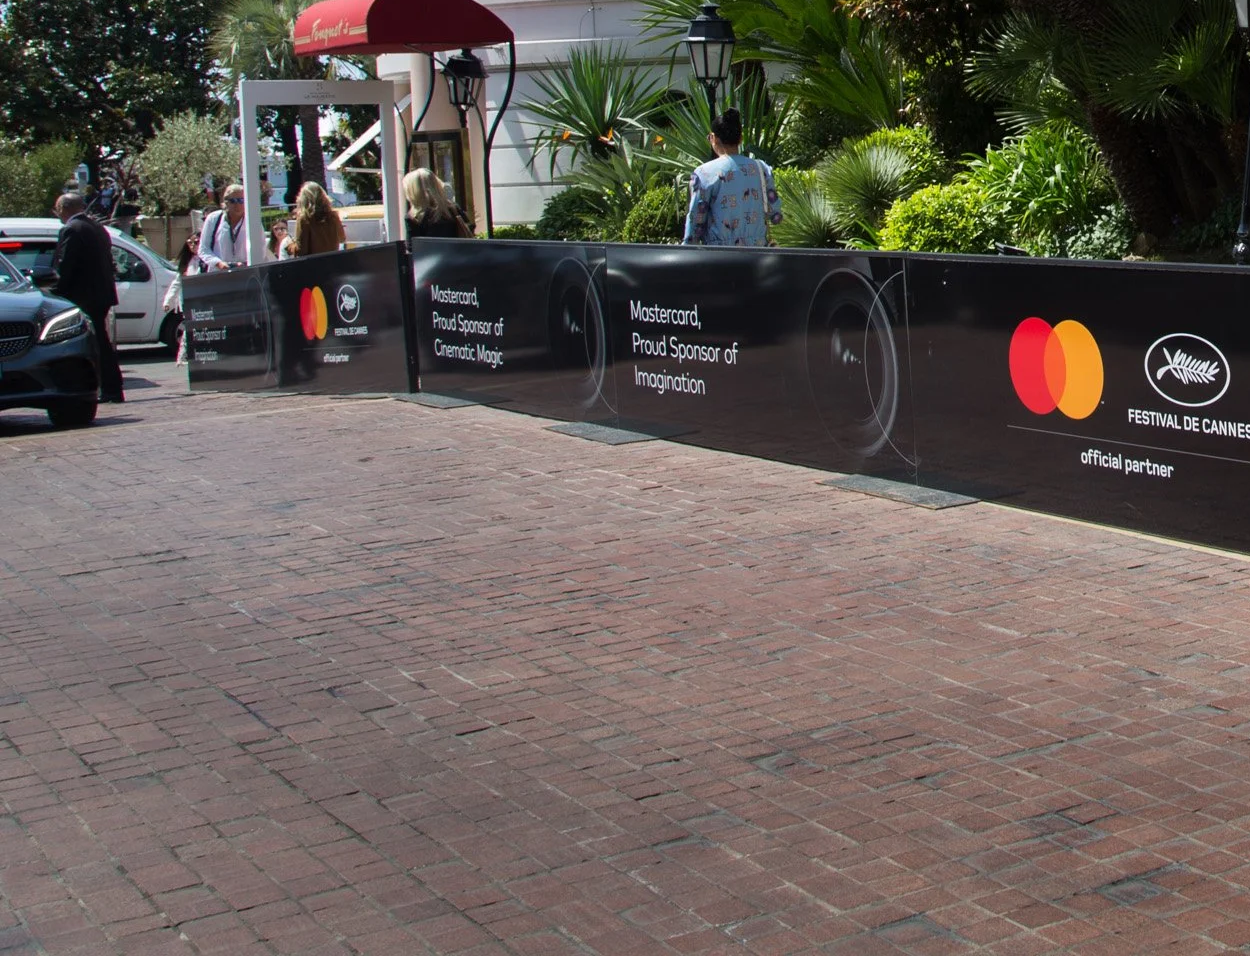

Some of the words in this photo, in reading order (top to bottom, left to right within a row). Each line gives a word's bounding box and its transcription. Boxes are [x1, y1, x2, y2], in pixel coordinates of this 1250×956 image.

[431, 284, 480, 308] Mastercard,
[432, 311, 457, 332] Proud
[458, 315, 493, 337] Sponsor
[494, 317, 505, 337] of
[630, 299, 702, 330] Mastercard,
[434, 338, 476, 362] Cinematic
[477, 344, 504, 369] Magic
[632, 331, 666, 358] Proud
[669, 335, 721, 364] Sponsor
[724, 342, 738, 365] of
[634, 365, 706, 395] Imagination
[1127, 407, 1182, 430] FESTIVAL
[1183, 415, 1200, 433] DE
[1080, 449, 1123, 471] official
[1124, 457, 1175, 479] partner
